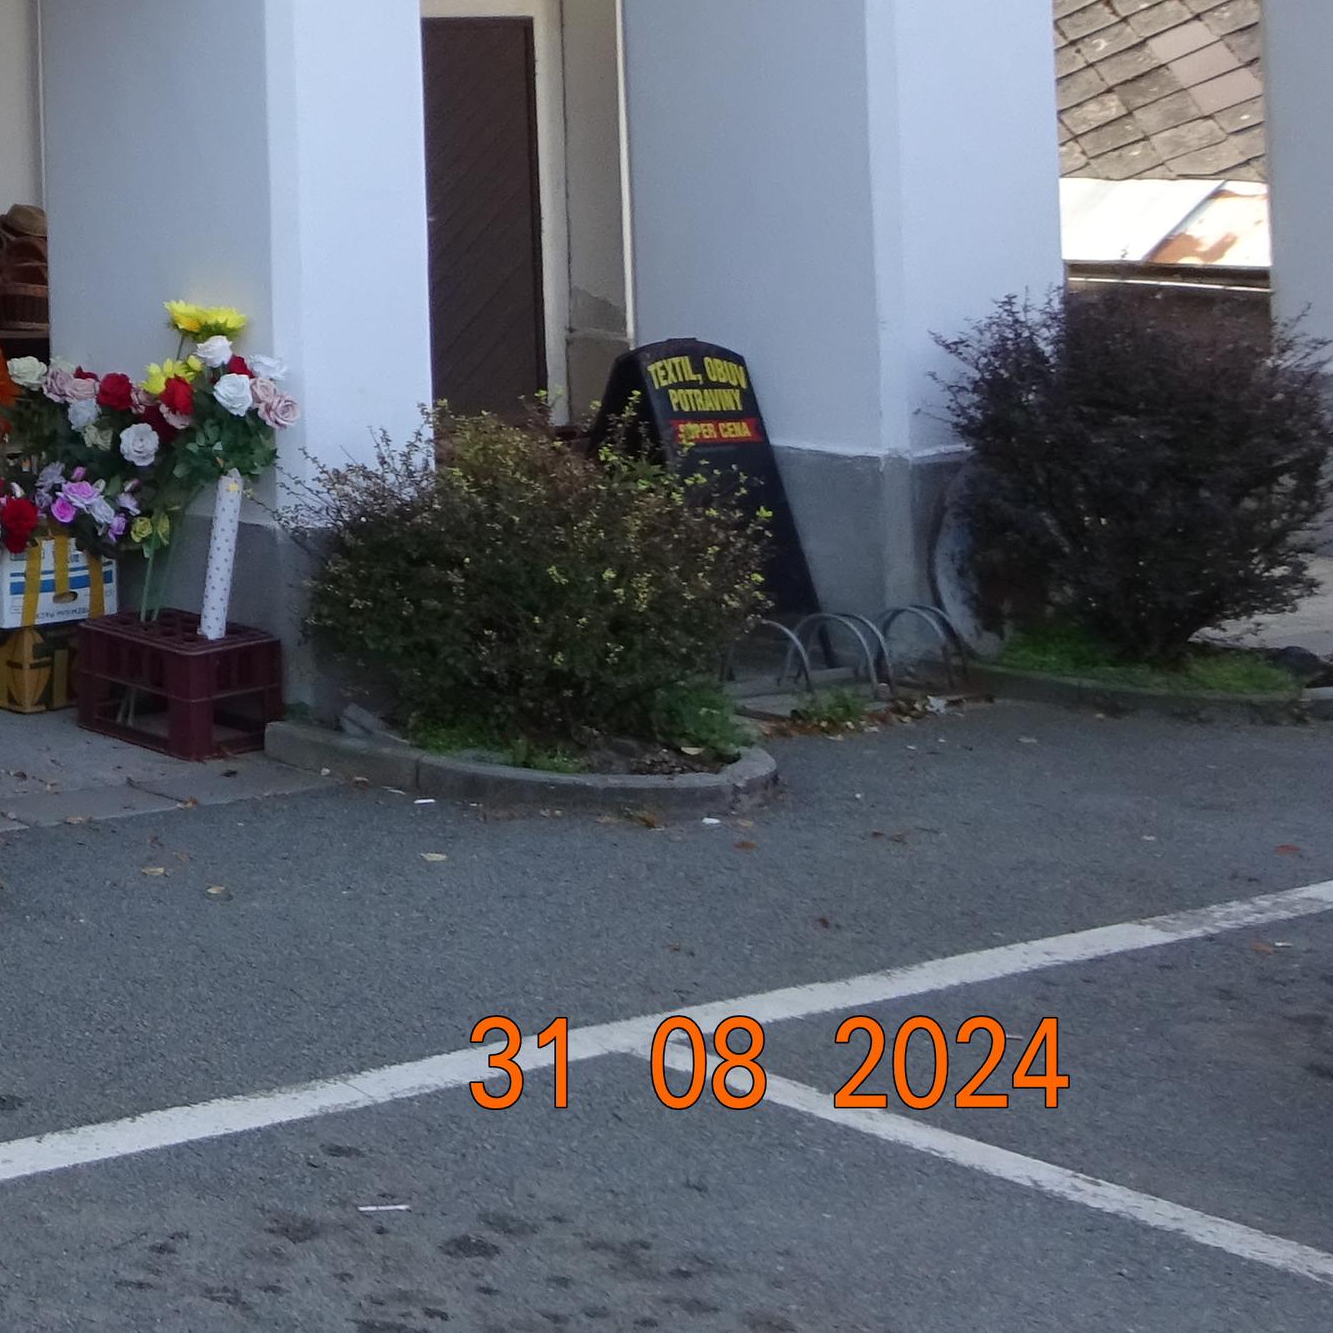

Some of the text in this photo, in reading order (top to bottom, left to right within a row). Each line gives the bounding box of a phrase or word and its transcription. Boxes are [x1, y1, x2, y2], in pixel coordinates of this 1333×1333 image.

[647, 355, 748, 390] TEXTIL, OBUV
[668, 388, 744, 412] POTRAVINY
[678, 421, 752, 440] SPER CENA
